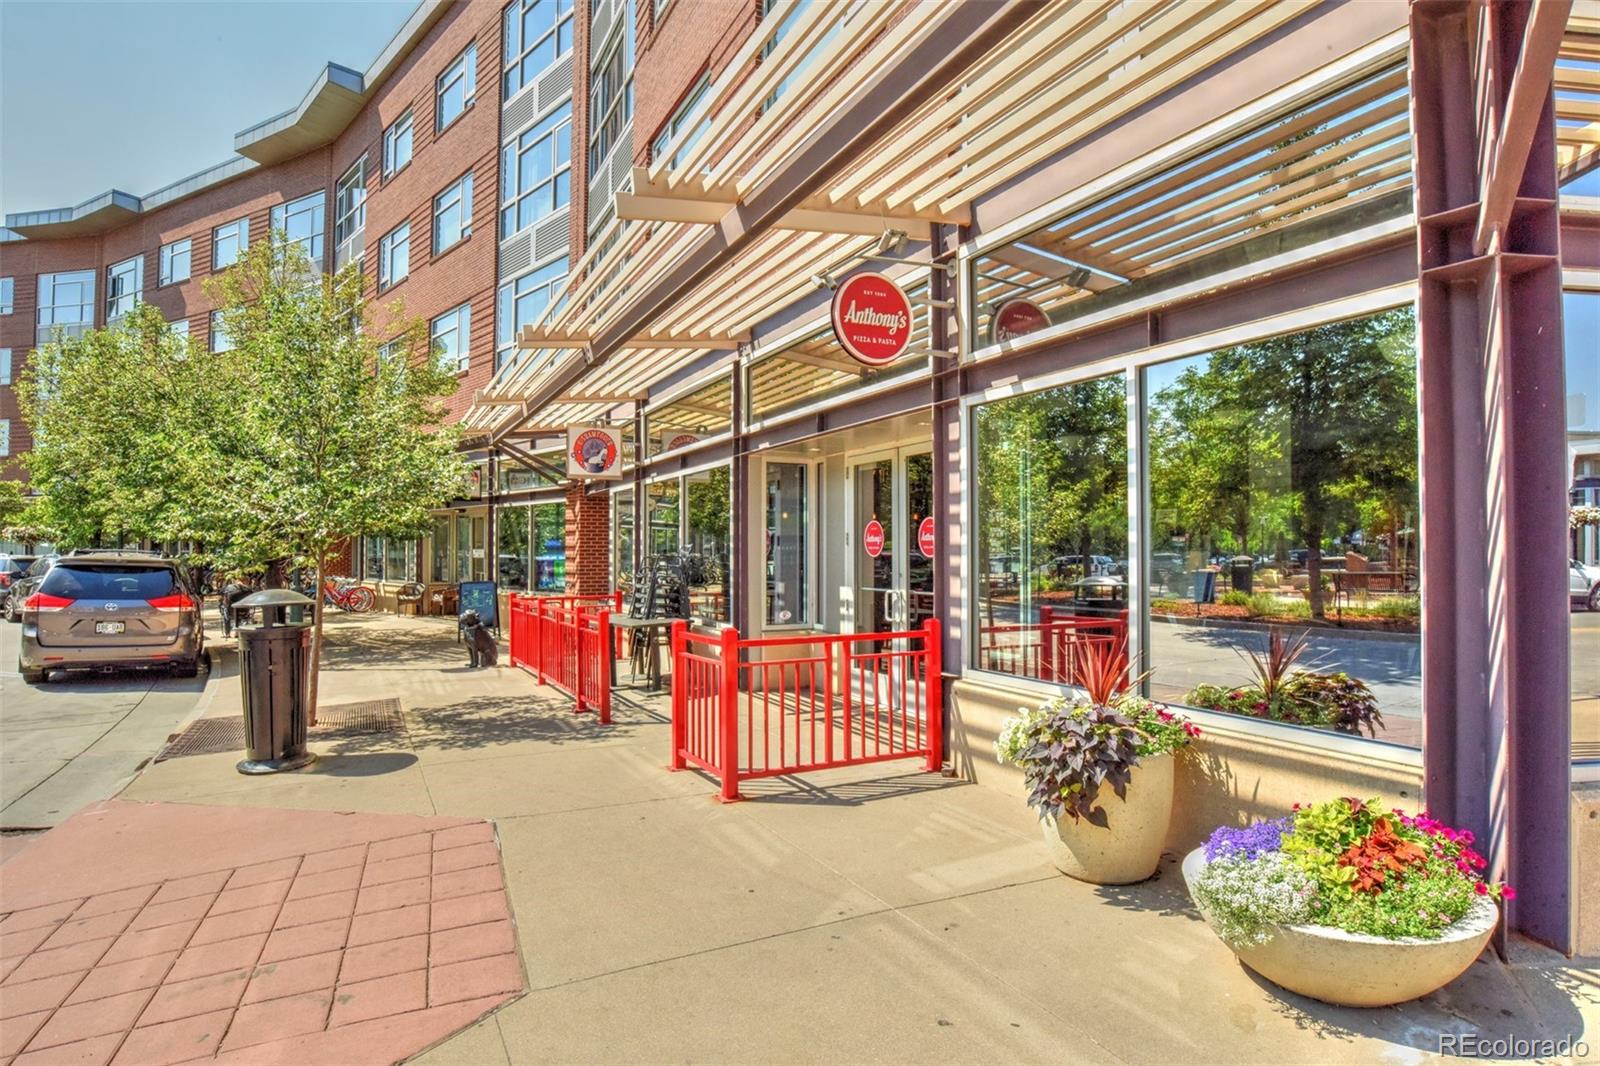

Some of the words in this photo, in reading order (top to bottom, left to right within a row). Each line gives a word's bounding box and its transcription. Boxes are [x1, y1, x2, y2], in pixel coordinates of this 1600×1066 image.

[844, 300, 907, 335] Anthony's
[853, 336, 871, 344] PIZZA
[872, 336, 877, 344] &
[878, 337, 896, 345] PASTA
